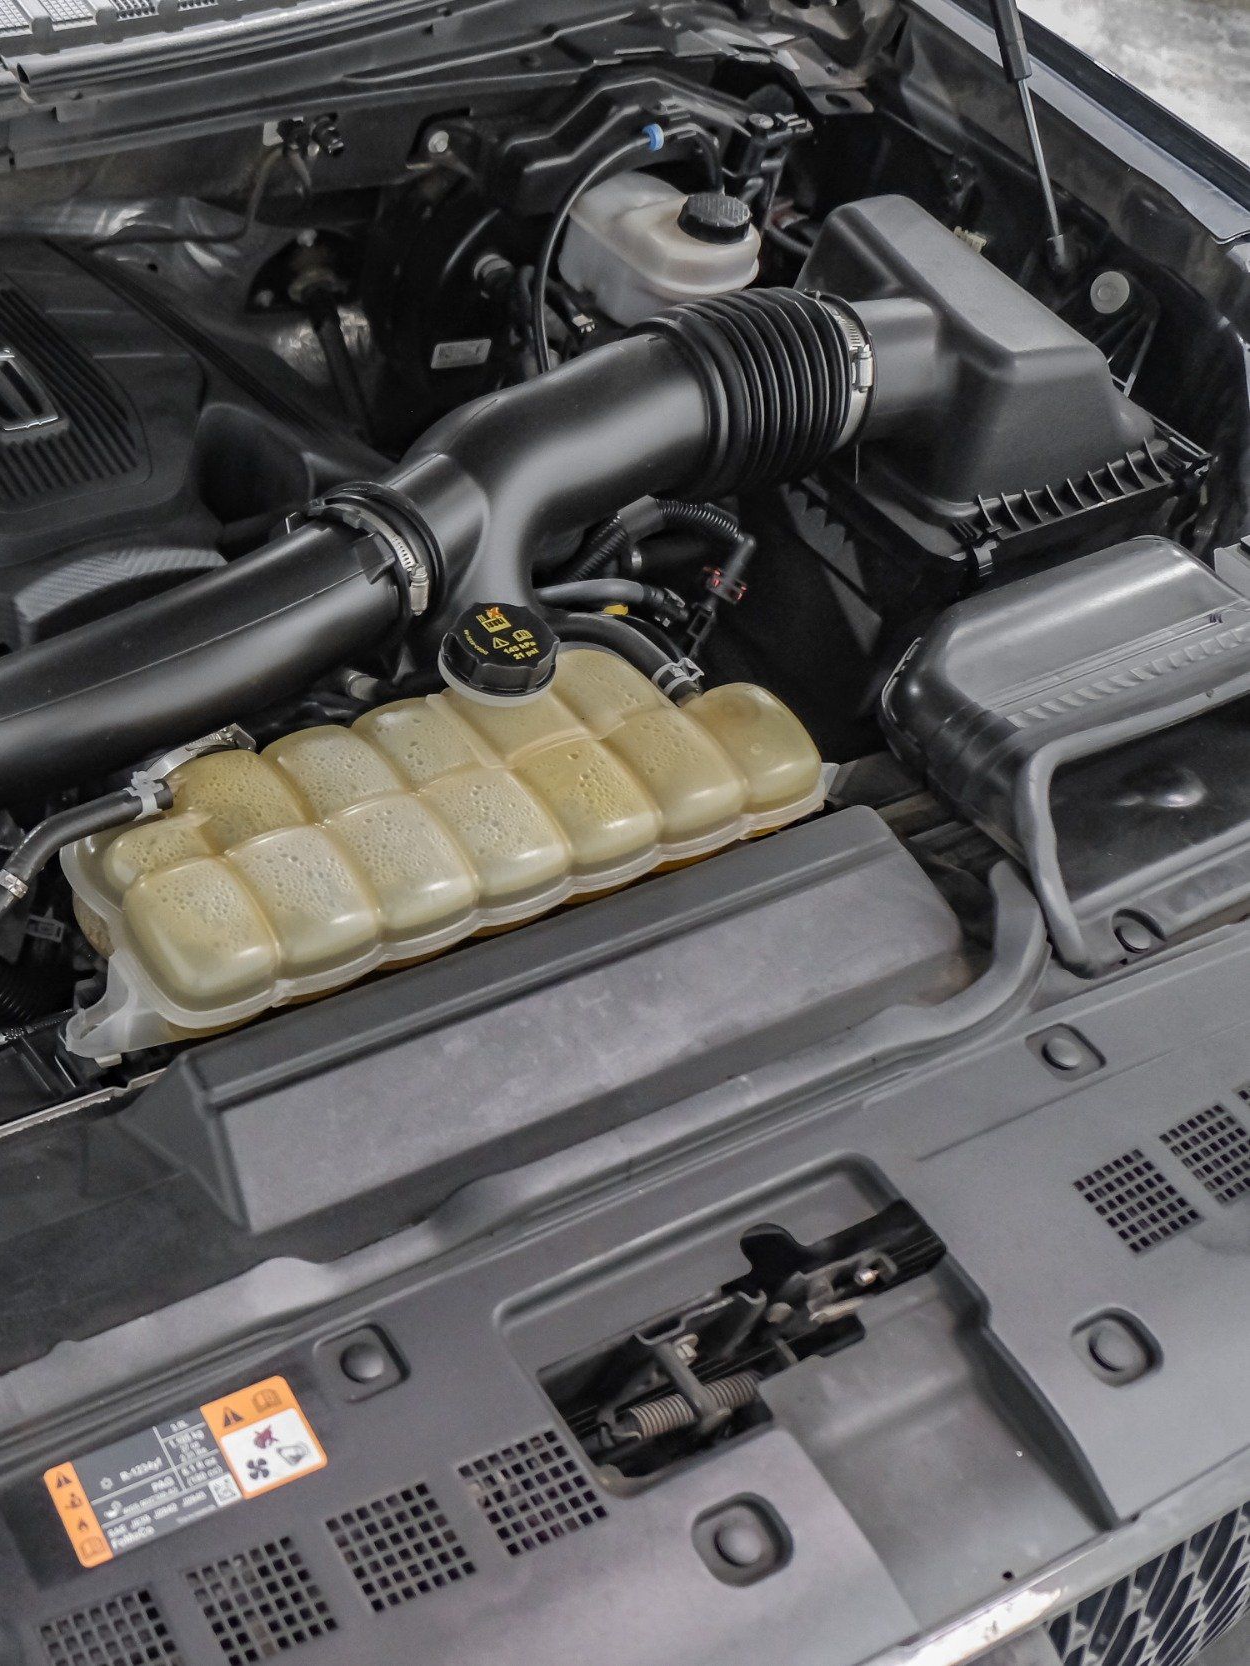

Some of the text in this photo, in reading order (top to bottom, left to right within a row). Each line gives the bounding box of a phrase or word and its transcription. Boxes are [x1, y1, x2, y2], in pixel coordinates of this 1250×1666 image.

[518, 641, 537, 649] kPa
[513, 647, 539, 660] 21 psi
